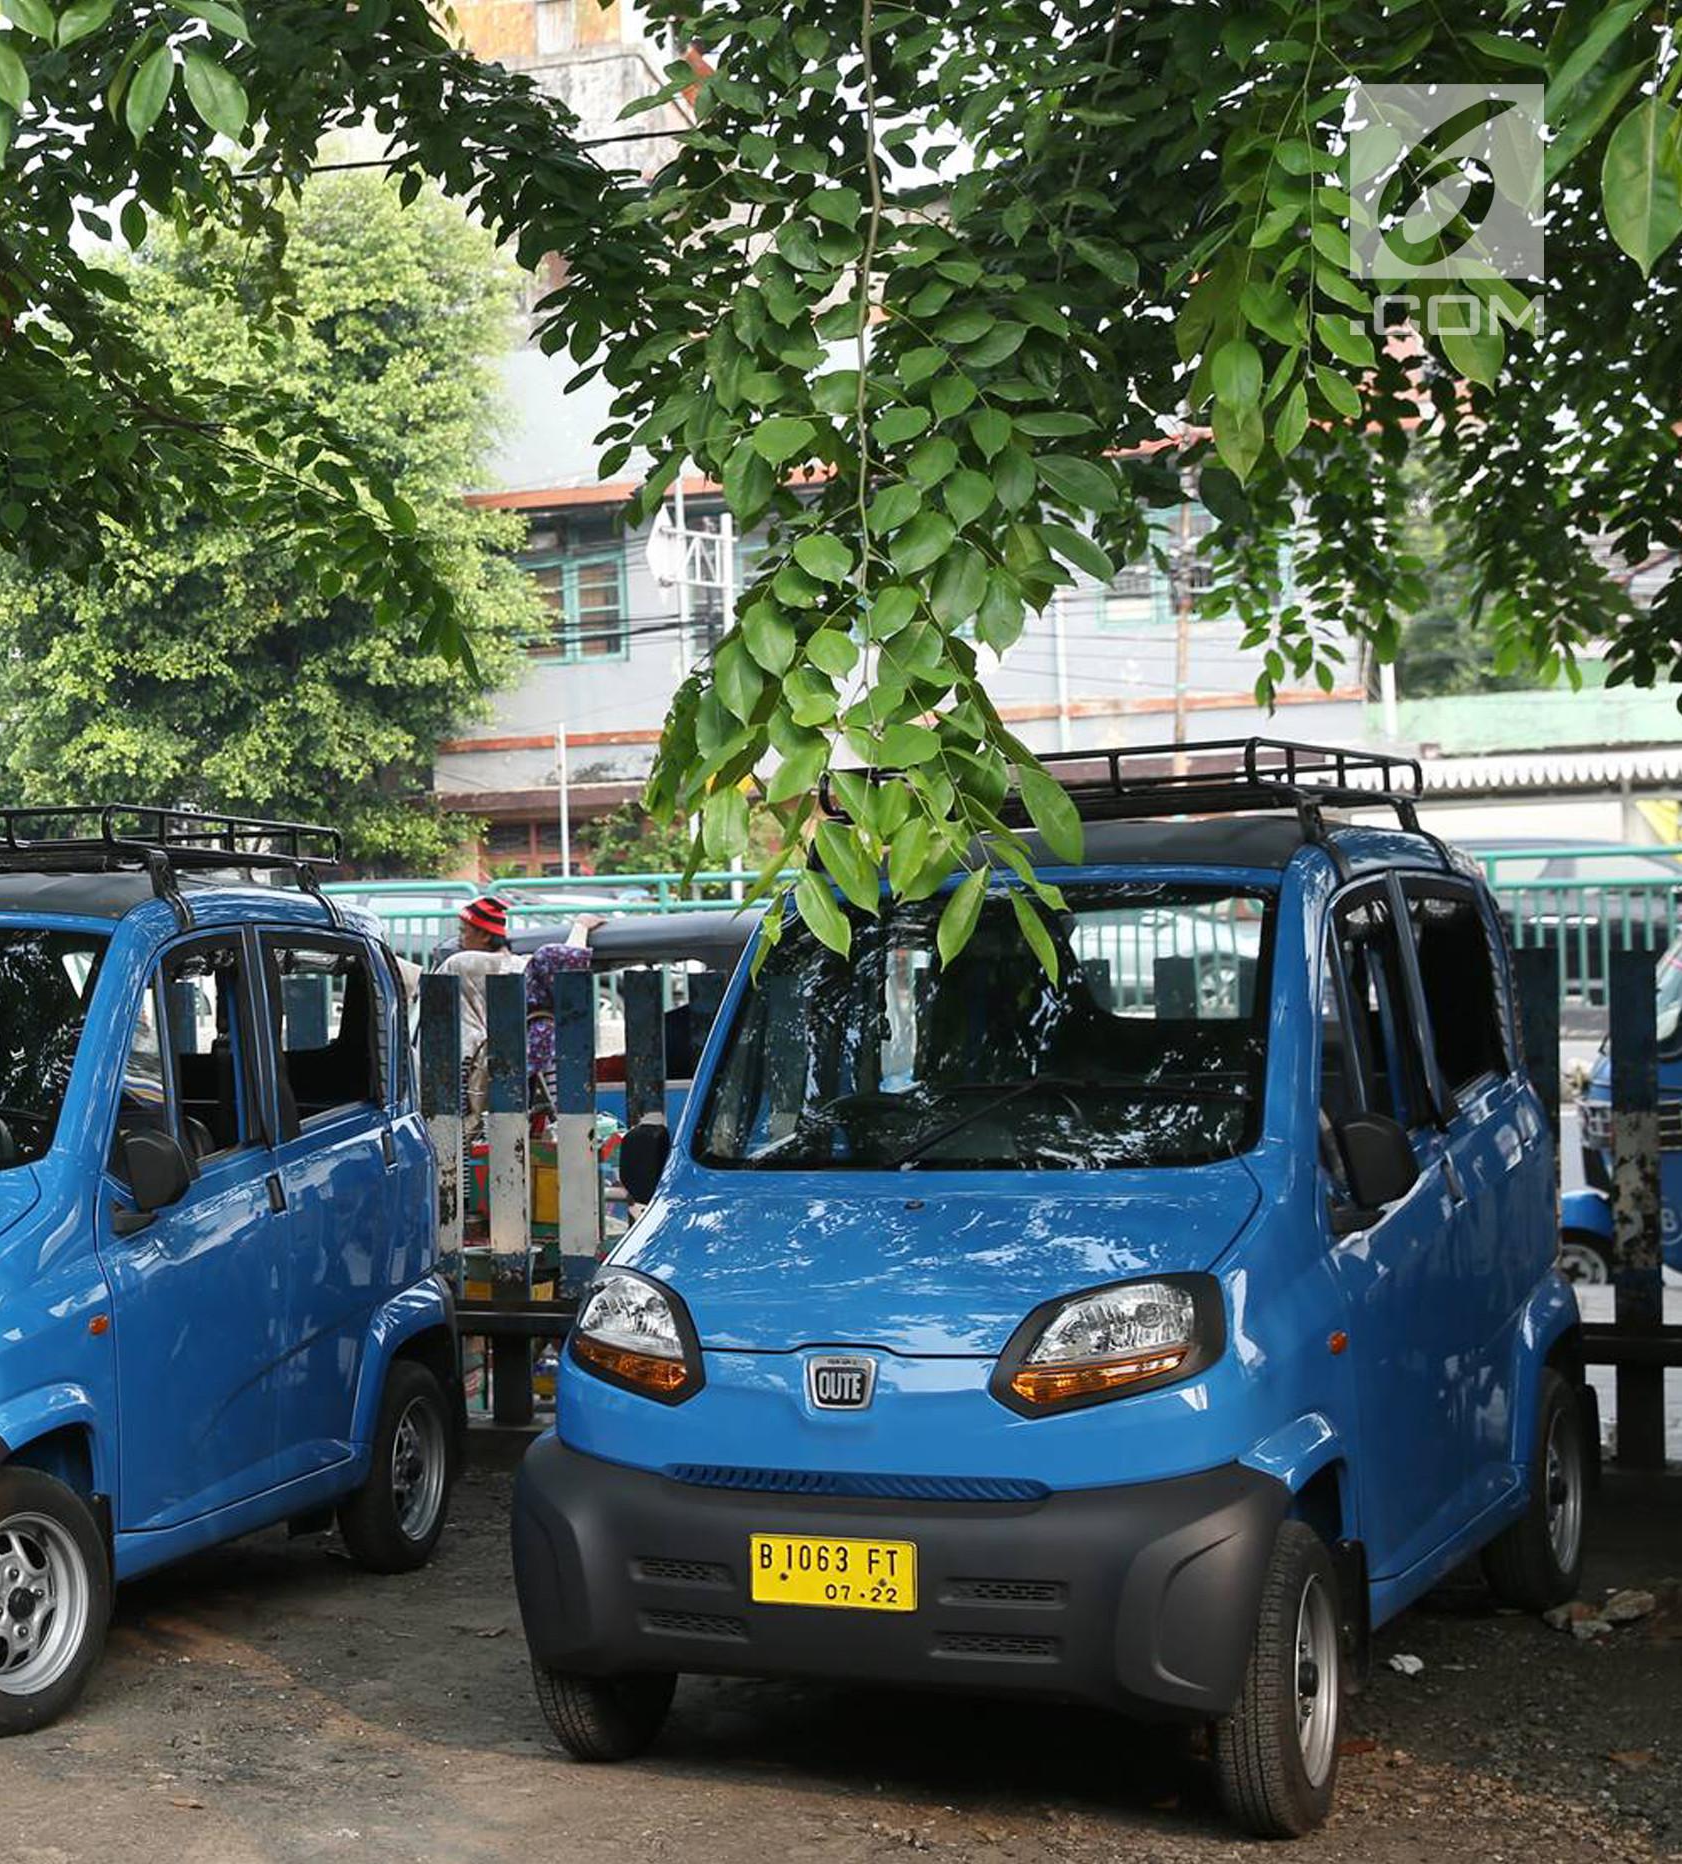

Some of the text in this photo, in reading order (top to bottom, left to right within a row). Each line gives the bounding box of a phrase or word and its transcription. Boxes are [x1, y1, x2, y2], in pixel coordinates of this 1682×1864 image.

[760, 1543, 898, 1576] B 1063 FT
